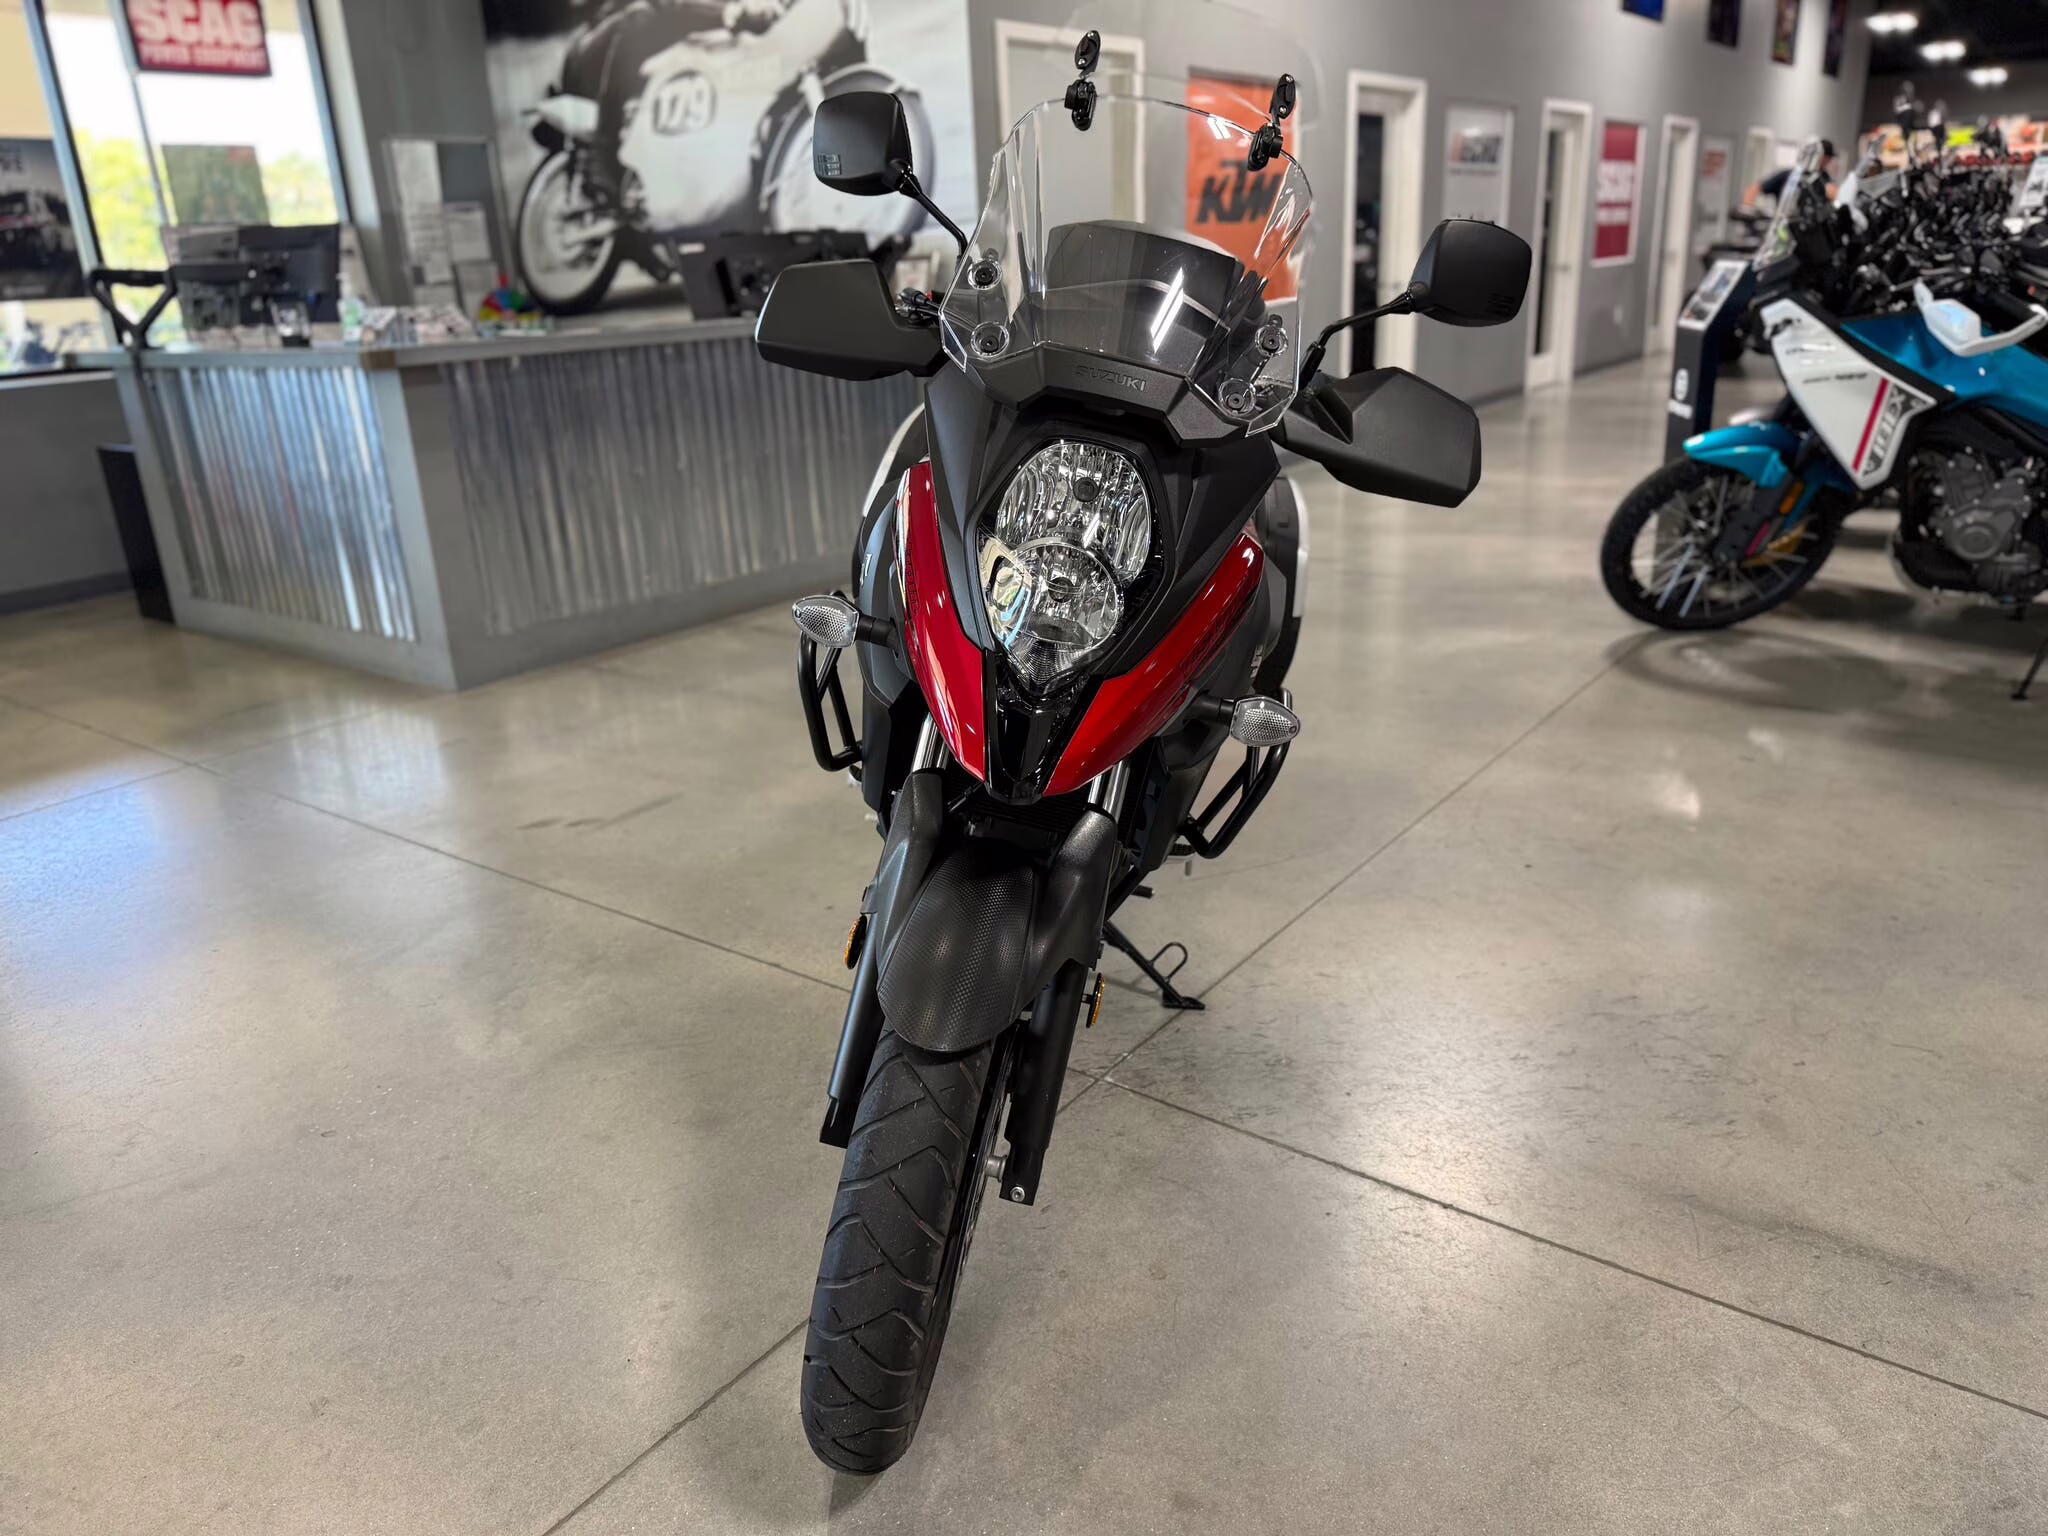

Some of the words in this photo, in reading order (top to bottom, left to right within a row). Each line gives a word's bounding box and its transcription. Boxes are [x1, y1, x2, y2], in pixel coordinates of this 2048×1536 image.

[129, 0, 263, 46] SCAG
[1197, 159, 1284, 224] KTM
[1075, 364, 1146, 392] SUZUKI
